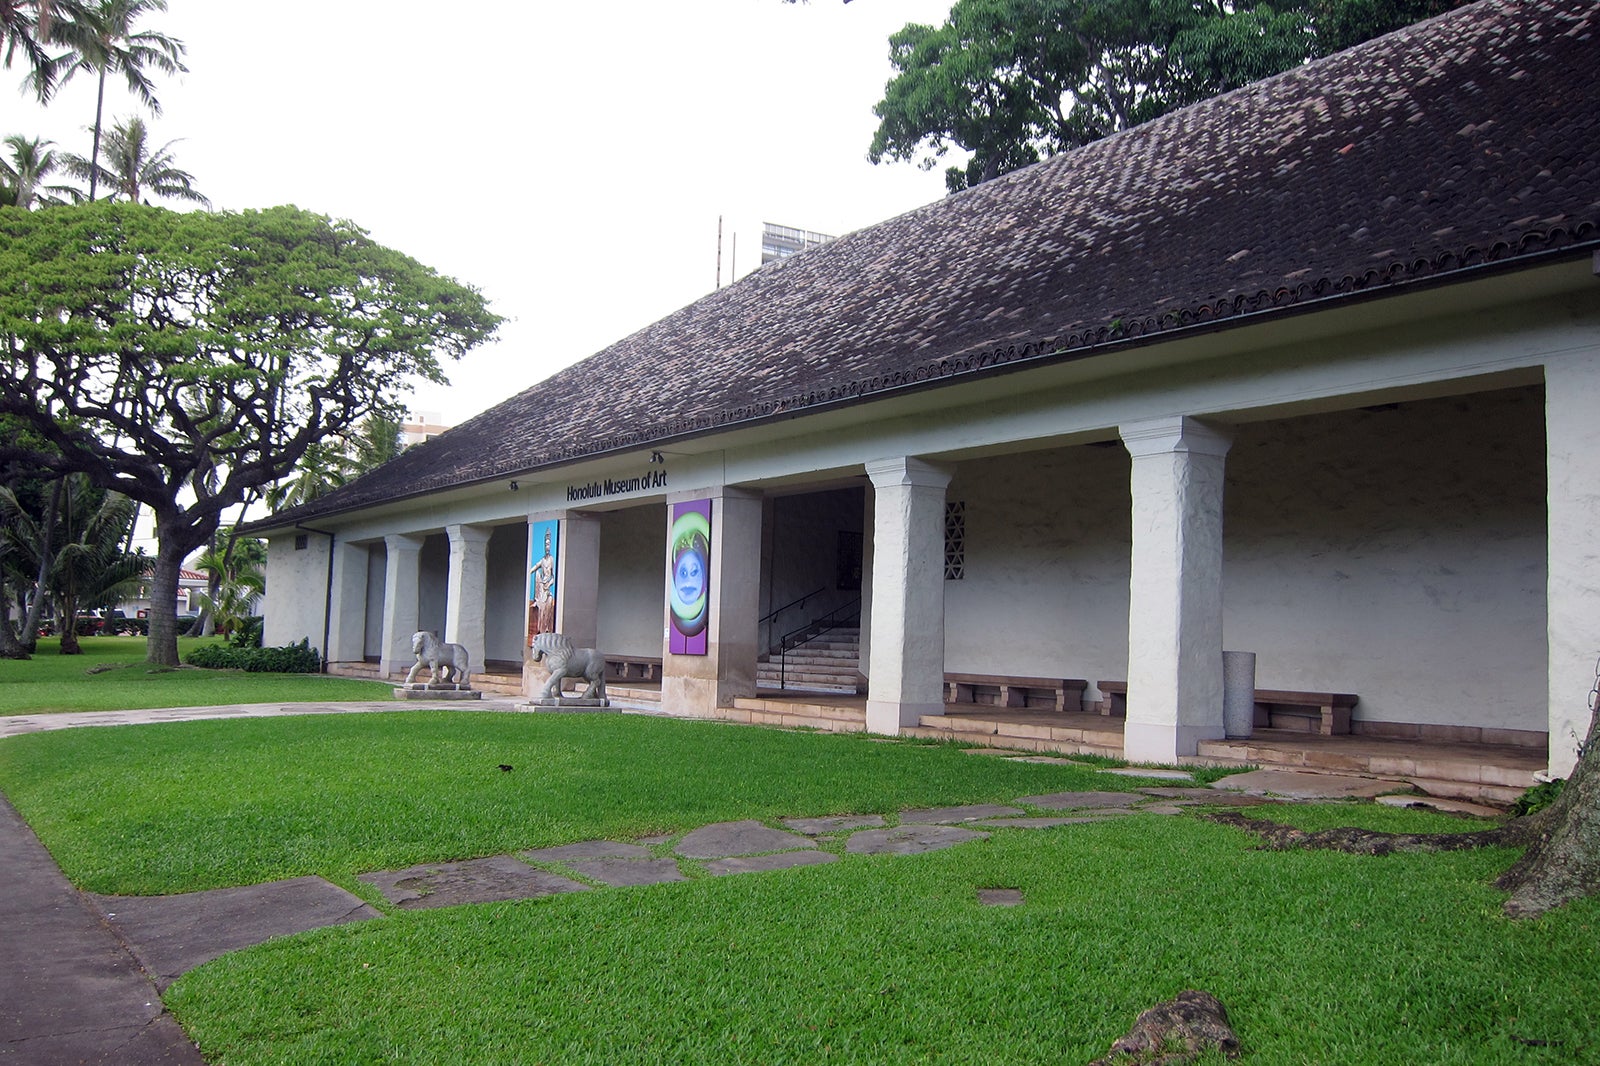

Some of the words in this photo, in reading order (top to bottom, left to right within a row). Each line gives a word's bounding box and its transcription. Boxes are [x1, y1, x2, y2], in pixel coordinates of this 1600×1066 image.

[567, 482, 602, 501] Honolulu
[603, 478, 640, 496] Museum
[641, 471, 651, 490] of
[652, 469, 667, 488] Art
